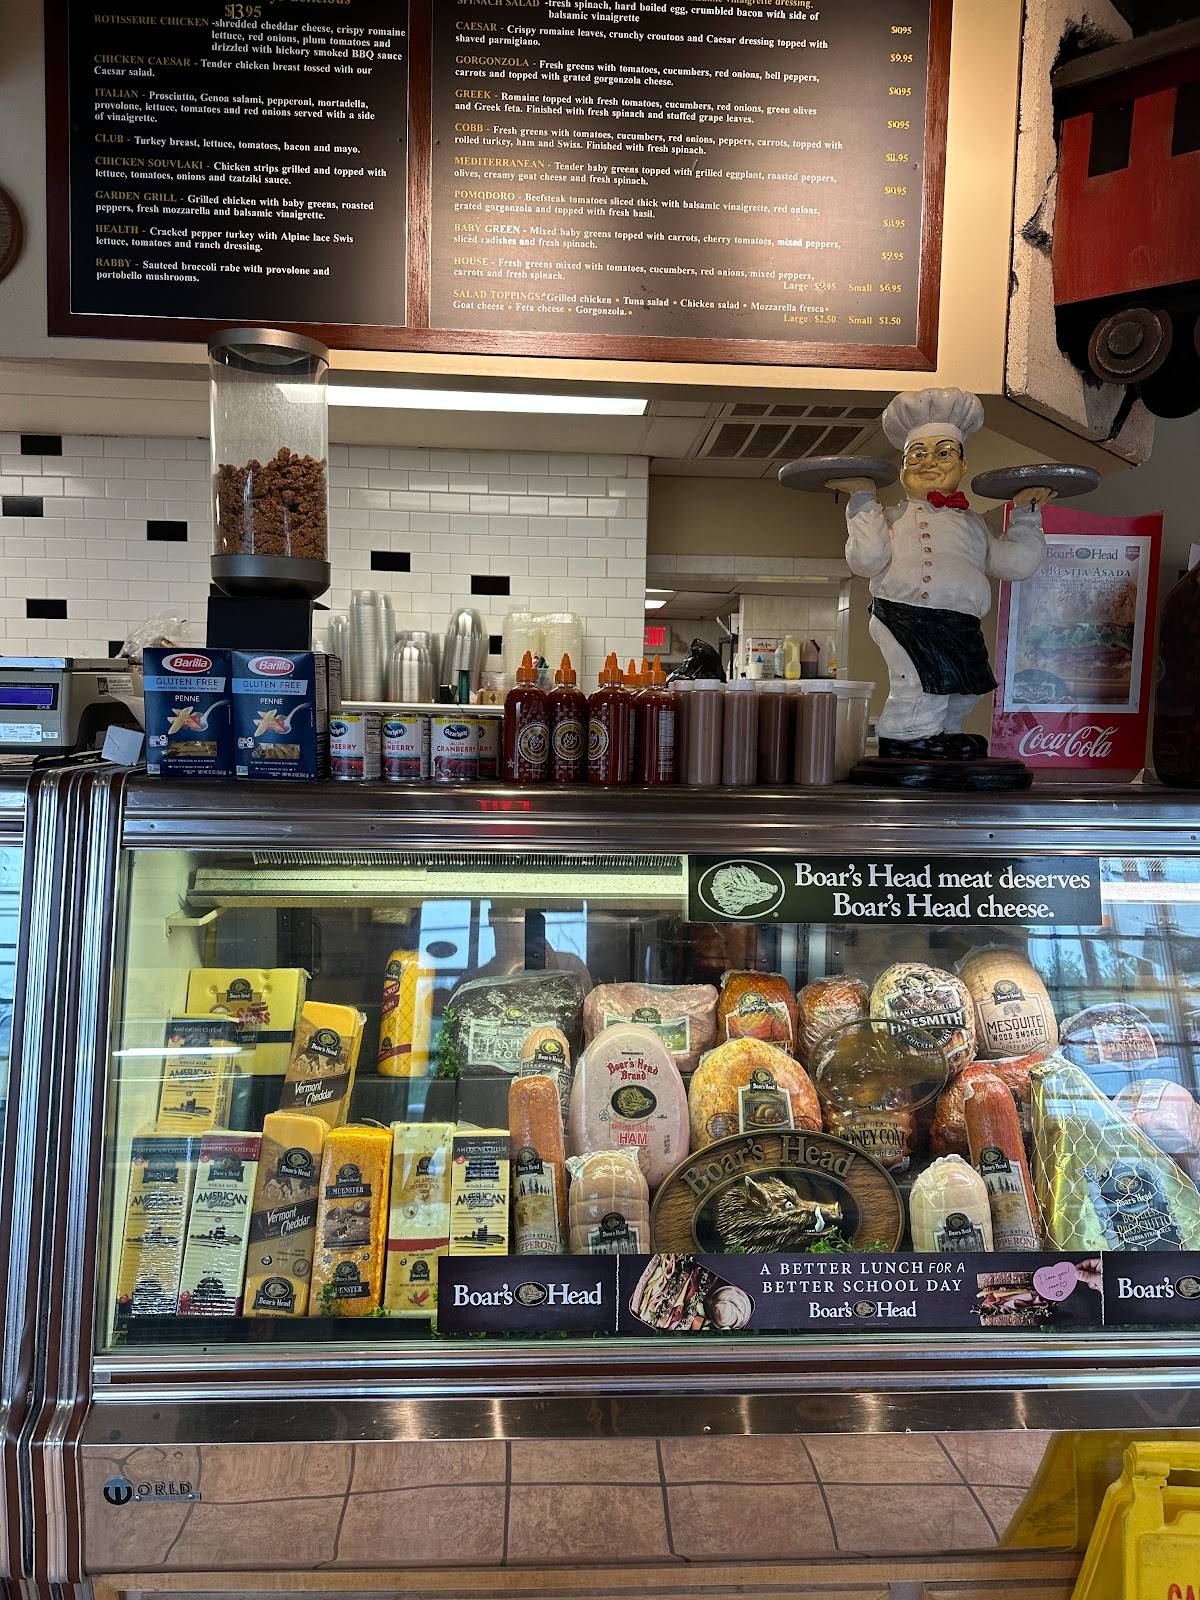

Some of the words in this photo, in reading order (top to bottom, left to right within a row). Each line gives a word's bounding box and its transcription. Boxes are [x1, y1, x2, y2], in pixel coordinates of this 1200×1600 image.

[549, 10, 588, 20] balsamic
[592, 12, 639, 24] vinaigrette
[212, 19, 257, 30] -shredded
[261, 21, 298, 32] cheddar
[302, 23, 333, 35] cheese,
[337, 24, 364, 37] crispy
[368, 26, 405, 37] romaine
[456, 33, 485, 43] shaved
[489, 34, 540, 48] parmigiano.
[94, 54, 143, 65] CHICKEN
[148, 56, 190, 67] CAESAR
[203, 58, 232, 69] Tender
[236, 60, 269, 70] chicken
[273, 61, 300, 71] breast
[304, 62, 330, 72] tossed
[334, 64, 353, 73] with
[456, 67, 486, 77] carrots
[490, 68, 505, 78] and
[509, 69, 537, 81] topped
[542, 70, 559, 80] with
[563, 71, 590, 84] grated
[594, 73, 640, 86] gorgonzola
[644, 75, 673, 85] cheese.
[95, 133, 123, 144] CLUB
[136, 135, 166, 147] Turkey
[170, 136, 199, 148] breast,
[204, 138, 235, 149] lettuce,
[239, 140, 280, 151] tomatoes,
[284, 141, 310, 151] bacon
[314, 142, 330, 152] and
[334, 145, 360, 155] mayo.
[455, 201, 481, 213] grated
[486, 202, 531, 215] gorgonzola
[536, 204, 550, 213] and
[555, 204, 583, 217] topped
[588, 206, 605, 215] with
[609, 206, 629, 216] fresh
[634, 207, 654, 217] basil.
[96, 224, 138, 234] HEALTH
[150, 226, 187, 236] Cracked
[192, 229, 222, 240] pepper
[226, 229, 254, 241] turkey
[258, 230, 277, 240] with
[282, 231, 309, 243] Alpine
[314, 232, 330, 242] lace
[334, 233, 353, 242] Swis
[96, 258, 130, 268] RABBY
[143, 260, 177, 270] Sauteed
[182, 261, 216, 271] broccoli
[220, 262, 240, 272] rabe
[244, 263, 262, 273] with
[266, 264, 310, 277] provolone
[314, 266, 329, 276] and
[97, 270, 142, 282] portobello
[146, 271, 199, 282] mushrooms.
[784, 282, 808, 291] Large
[849, 284, 872, 292] Small
[880, 284, 901, 293] $6.95
[454, 299, 473, 309] Goat
[478, 300, 504, 310] cheese
[516, 301, 534, 311] Feta
[538, 302, 564, 312] cheese
[576, 303, 626, 316] Gorgonzola.
[784, 314, 808, 323] Large
[815, 315, 836, 324] $2.50
[849, 316, 872, 324] Small
[880, 317, 901, 325] $1.50
[1046, 548, 1074, 559] Boar's
[1092, 549, 1118, 559] Head
[1050, 566, 1088, 576] BESTIA
[1093, 568, 1130, 576] ASADA
[174, 658, 208, 667] Barilla
[258, 661, 290, 670] Barilla
[156, 678, 192, 686] GLUTEN
[243, 679, 276, 688] GLUTEN
[1019, 725, 1119, 758] Coca-Cola
[795, 863, 861, 887] Boar's
[868, 864, 932, 888] Head
[938, 869, 992, 888] meat
[999, 866, 1090, 889] deserves
[833, 894, 901, 917] Boar's
[907, 895, 971, 918] Head
[977, 896, 1055, 918] cheese.
[987, 1015, 1044, 1034] MESQUITE
[907, 1035, 934, 1048] CHICKEN
[992, 1033, 1012, 1041] WOOD
[1016, 1029, 1042, 1038] SMOKED
[606, 1058, 634, 1075] Boar's
[638, 1058, 658, 1075] Head
[621, 1071, 646, 1080] Brand
[295, 1080, 322, 1095] Vermont
[306, 1090, 333, 1106] Cheddar
[619, 1132, 647, 1145] HAM
[281, 1166, 297, 1174] Boar's
[298, 1169, 310, 1177] Head
[681, 1139, 766, 1199] Boar's
[781, 1136, 855, 1178] Head
[196, 1192, 248, 1205] AMERICAN
[456, 1192, 505, 1205] AMERICAN
[1137, 1191, 1152, 1202] Head
[267, 1206, 297, 1225] Vermont
[281, 1216, 310, 1236] Cheddar
[760, 1262, 771, 1274] A
[780, 1263, 852, 1274] BETTER
[861, 1262, 923, 1274] LUNCH
[928, 1264, 952, 1273] FOR
[956, 1263, 965, 1273] A
[763, 1280, 835, 1293] BETTER
[843, 1280, 919, 1292] SCHOOL
[927, 1280, 962, 1291] DAY
[1118, 1277, 1174, 1299] Boar's
[258, 1296, 275, 1305] Boar's
[454, 1283, 513, 1306] Boar's
[548, 1282, 602, 1305] Head
[808, 1302, 852, 1318] Boar's
[877, 1301, 917, 1318] Head
